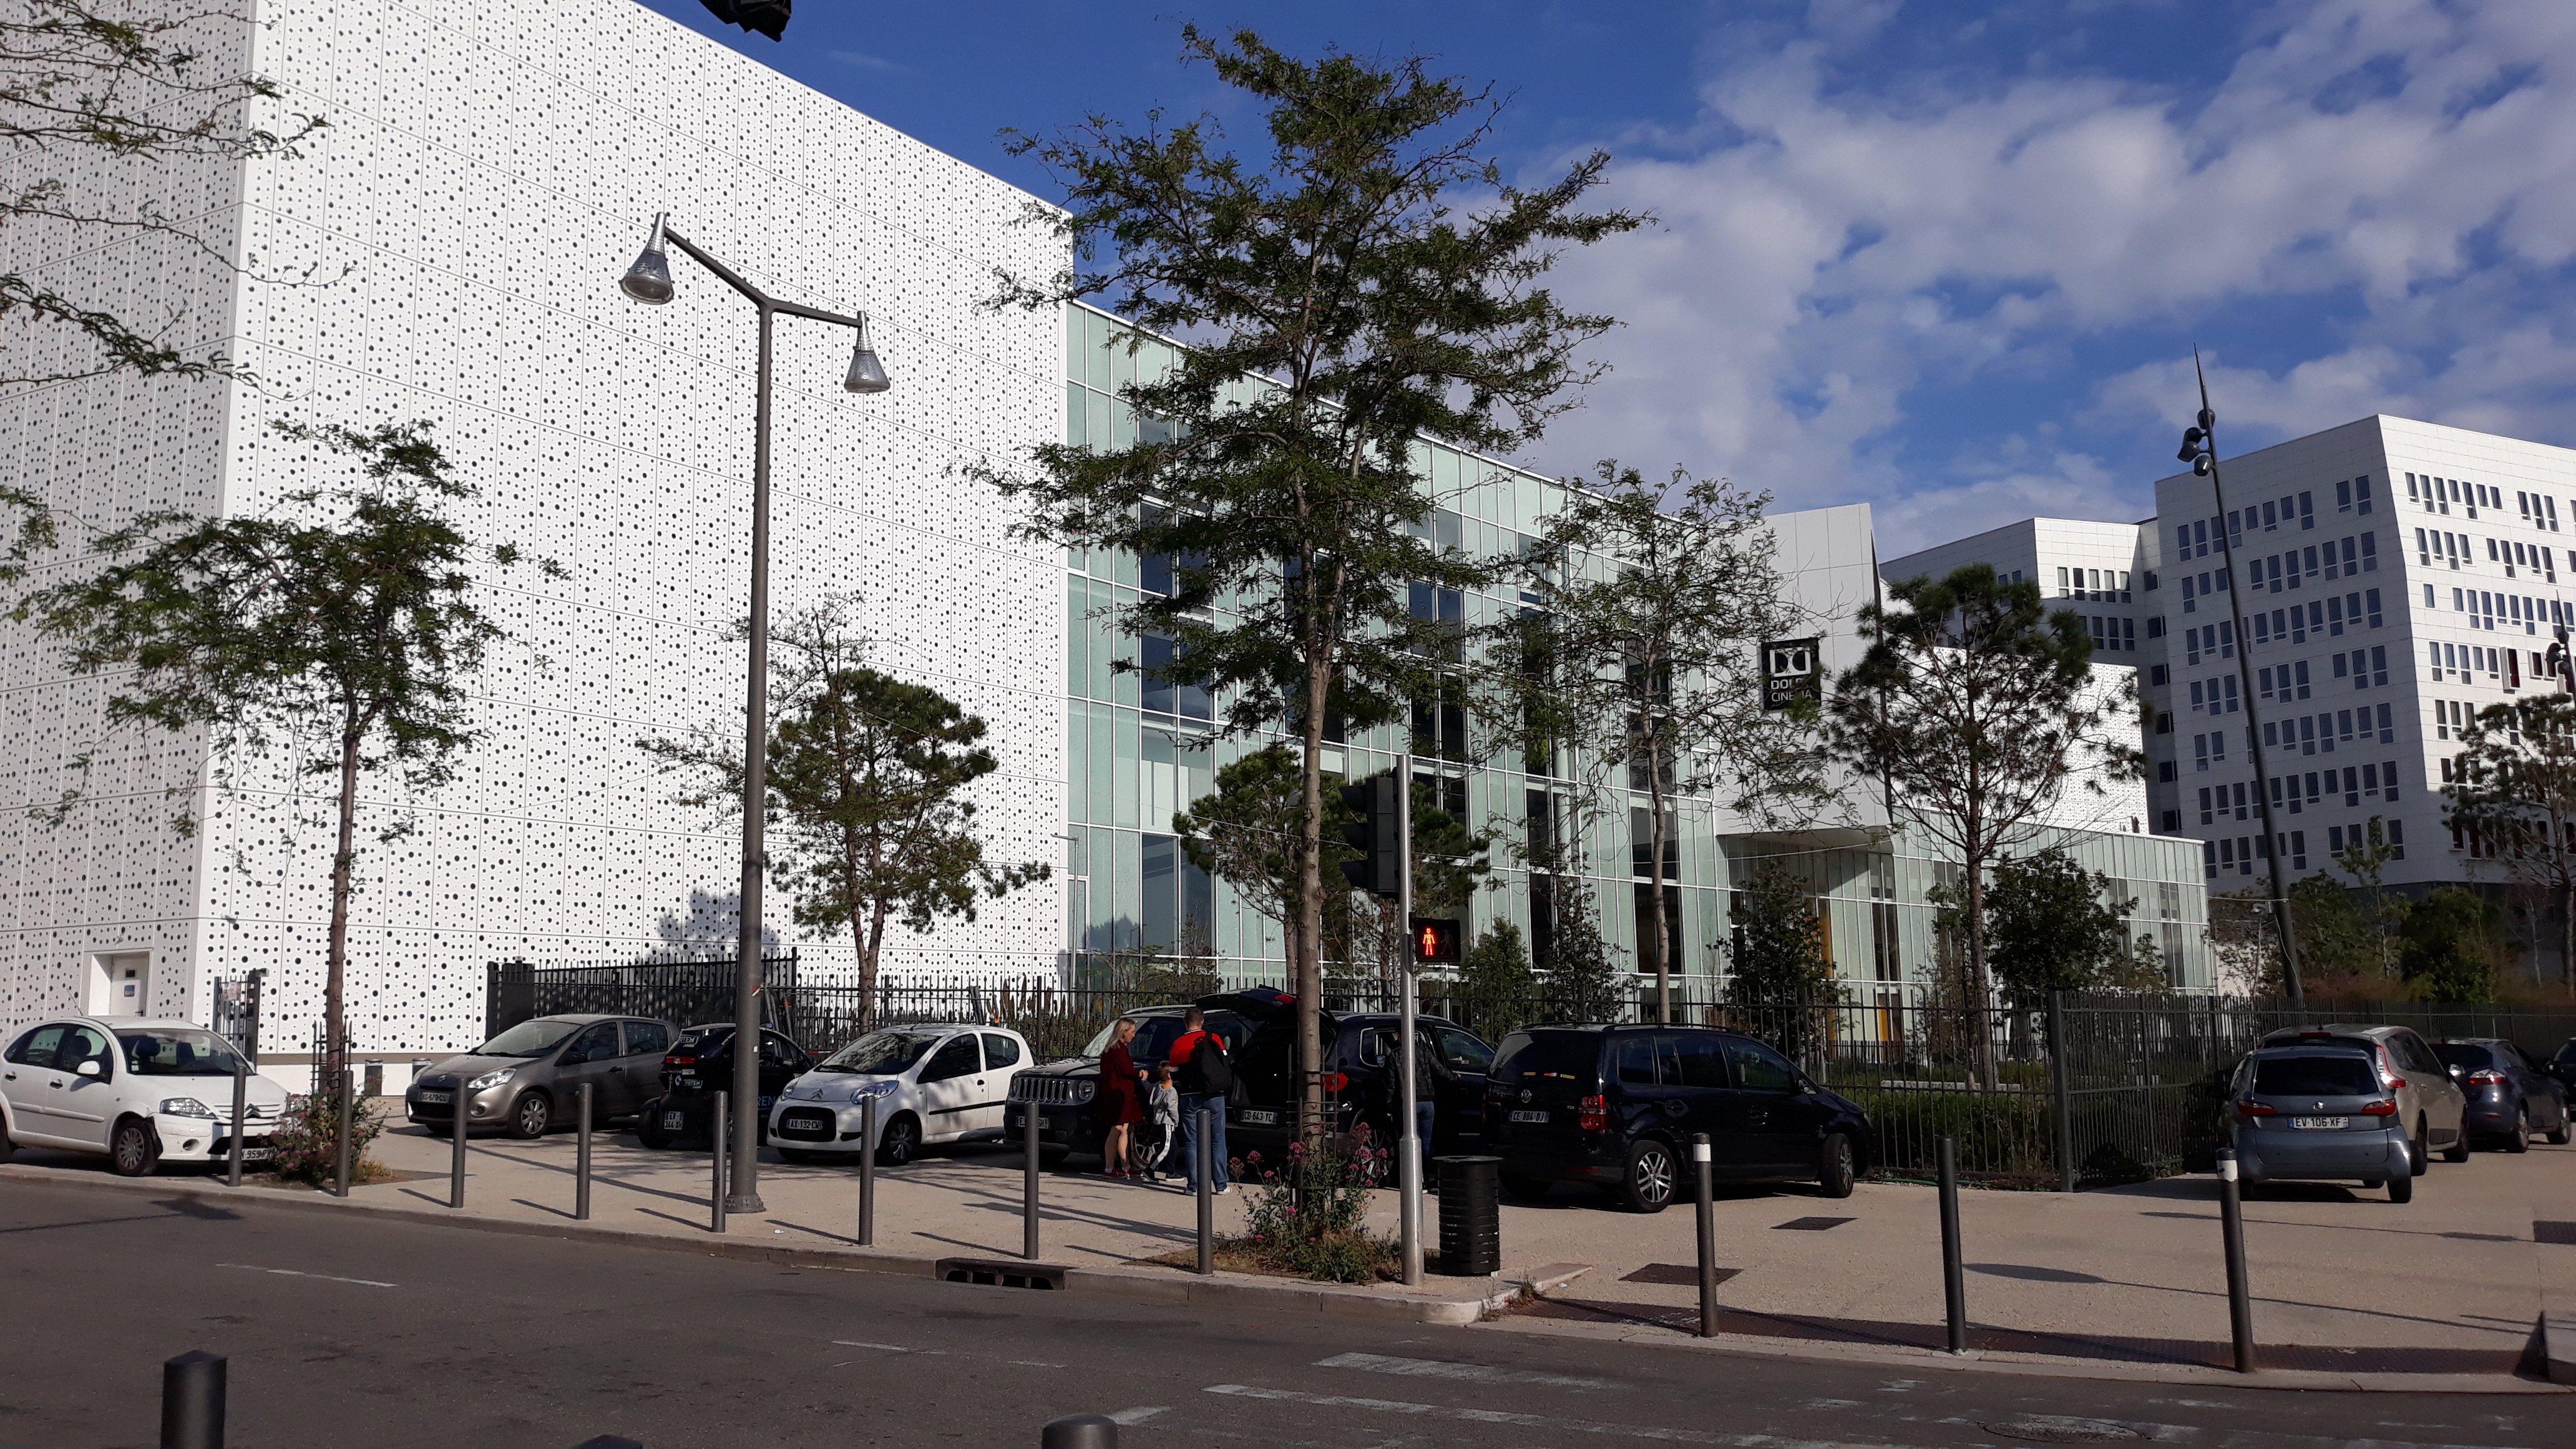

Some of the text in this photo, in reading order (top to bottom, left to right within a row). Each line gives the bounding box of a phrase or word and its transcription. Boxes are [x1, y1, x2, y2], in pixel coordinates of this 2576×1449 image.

[1771, 678, 1807, 690] DOLB
[1771, 690, 1812, 702] CINEA
[1244, 1111, 1272, 1121] CD-643-YC
[1513, 1111, 1544, 1121] CE-804-DJ
[2295, 1118, 2341, 1127] EV-106-XF
